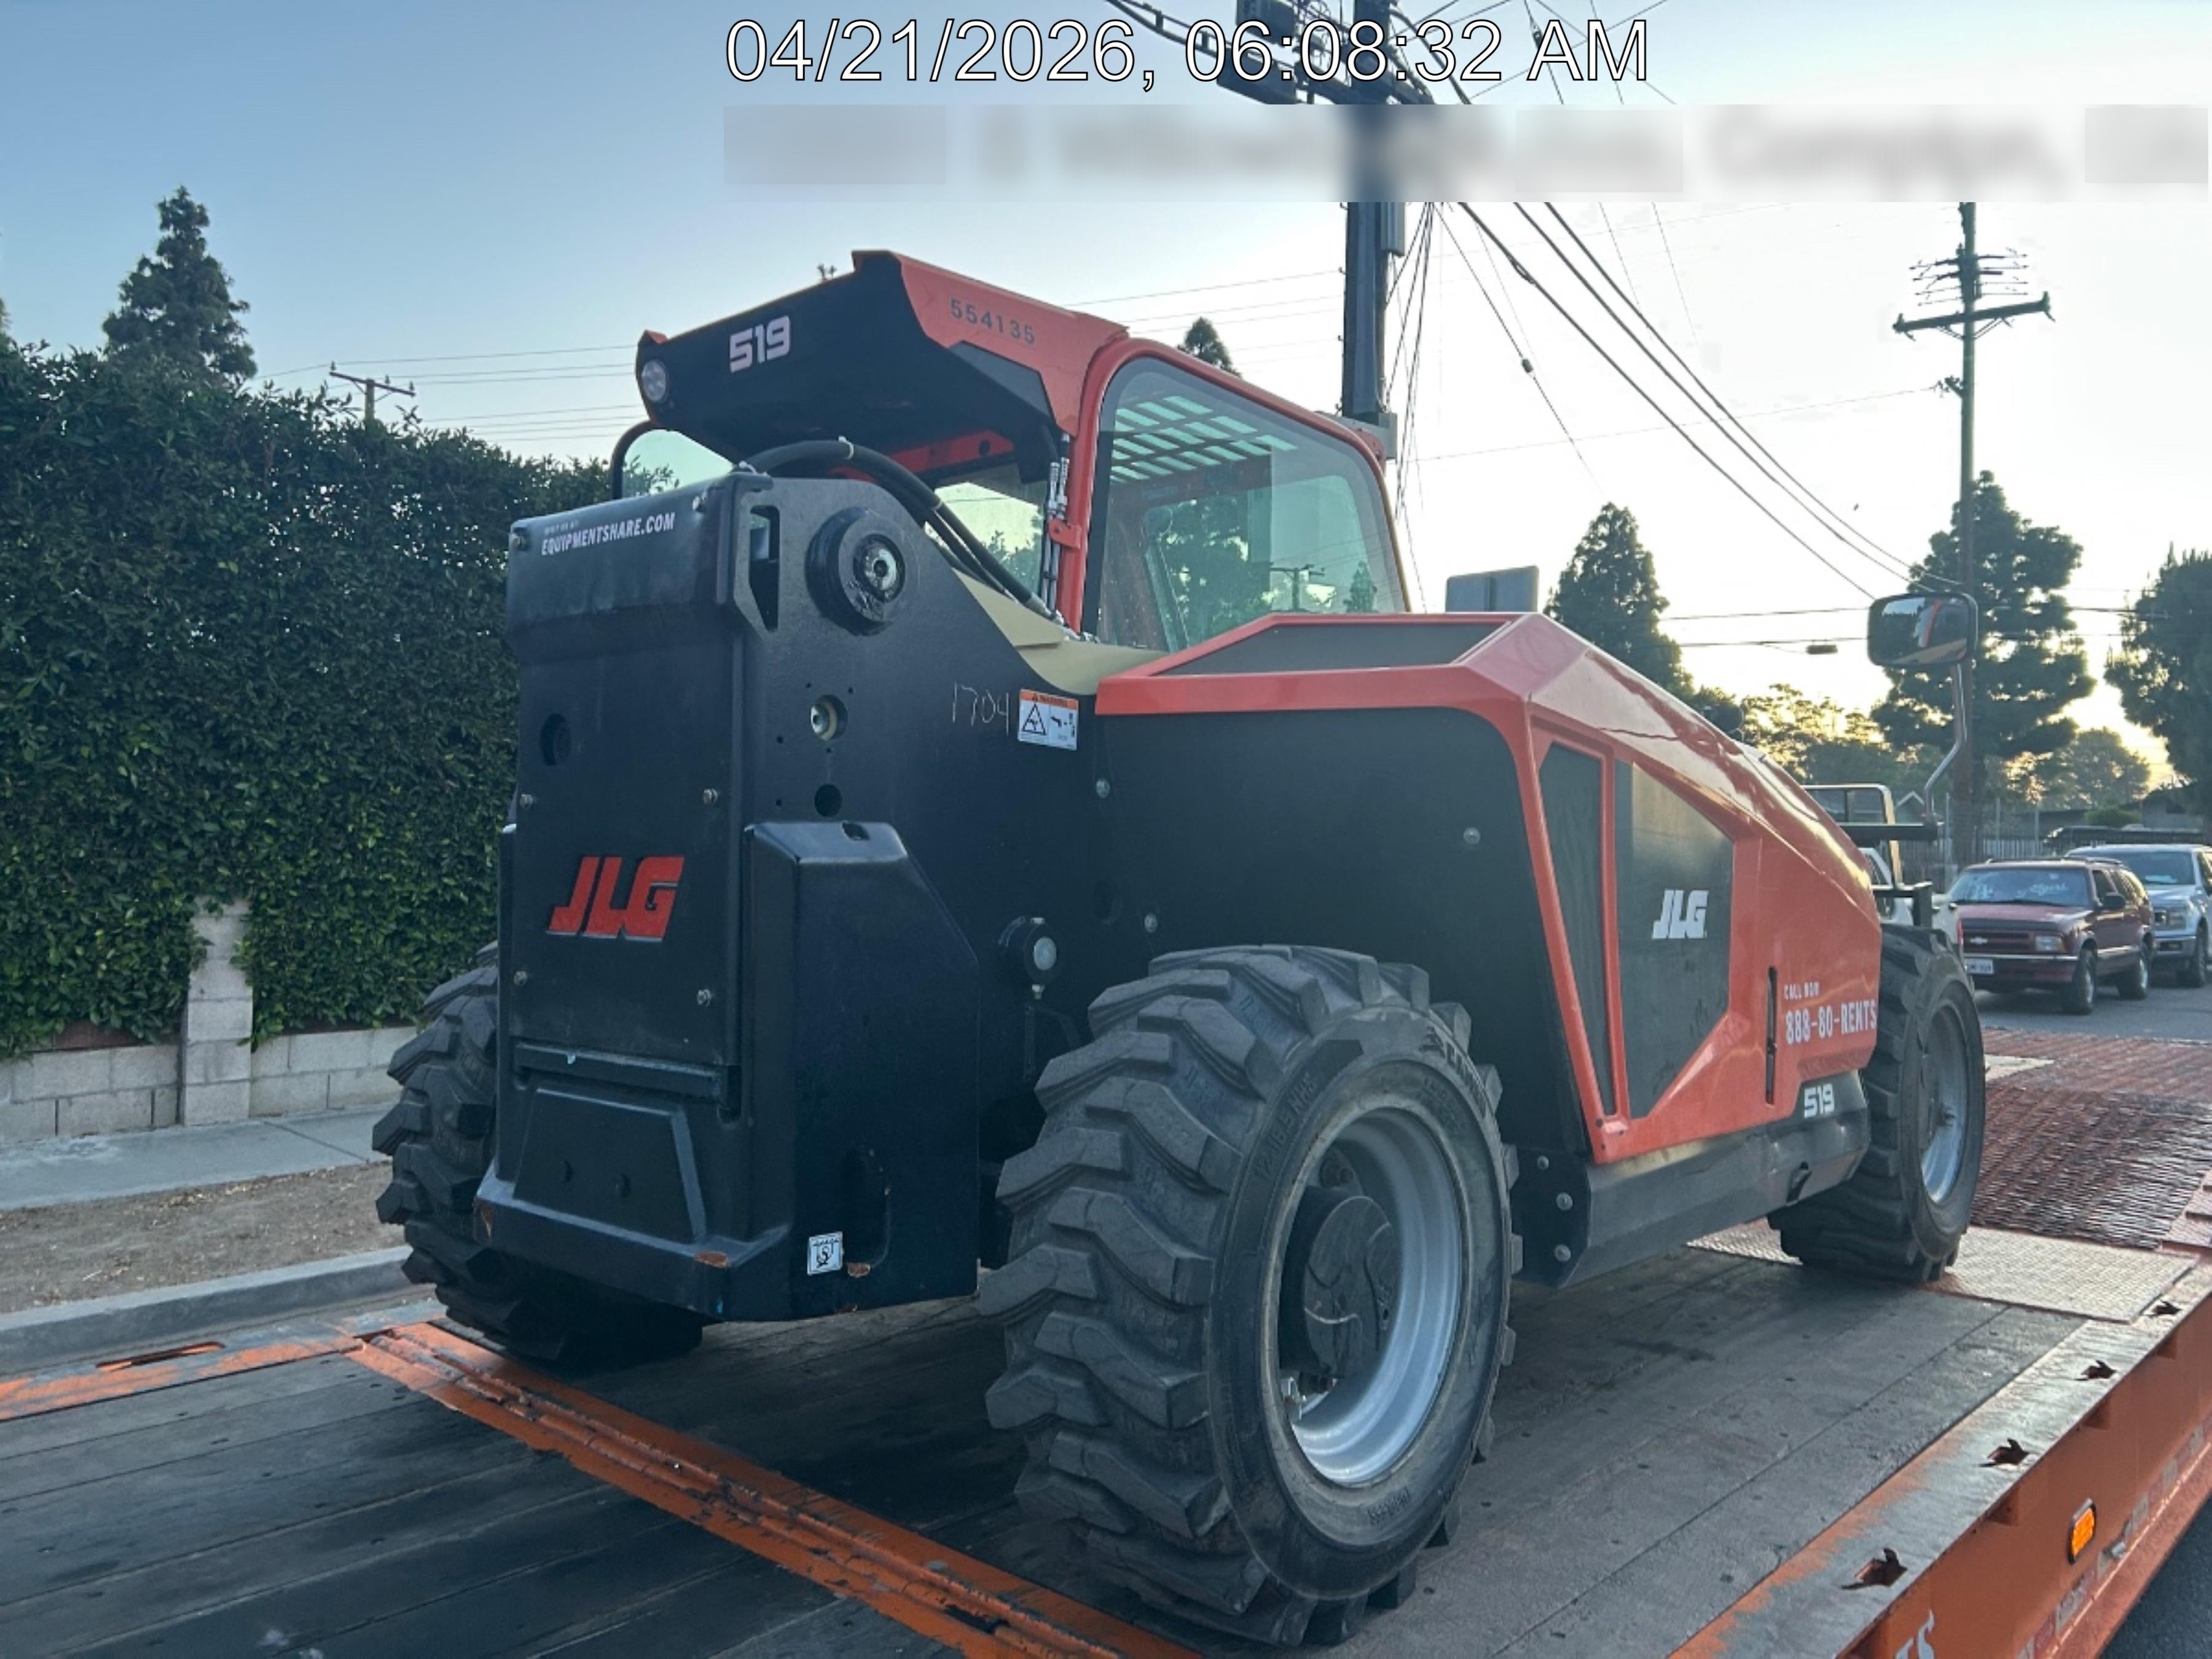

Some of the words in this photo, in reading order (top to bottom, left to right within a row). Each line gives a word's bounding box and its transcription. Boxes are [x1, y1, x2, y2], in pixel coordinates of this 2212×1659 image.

[729, 315, 791, 372] 519
[951, 298, 1035, 345] 554135
[541, 512, 676, 555] EQUIPMENTSHARE.COM
[545, 856, 684, 943] JLG
[1651, 889, 1709, 939] JLG
[1786, 999, 1877, 1045] 888-80-RENTS
[1803, 1083, 1835, 1119] 519
